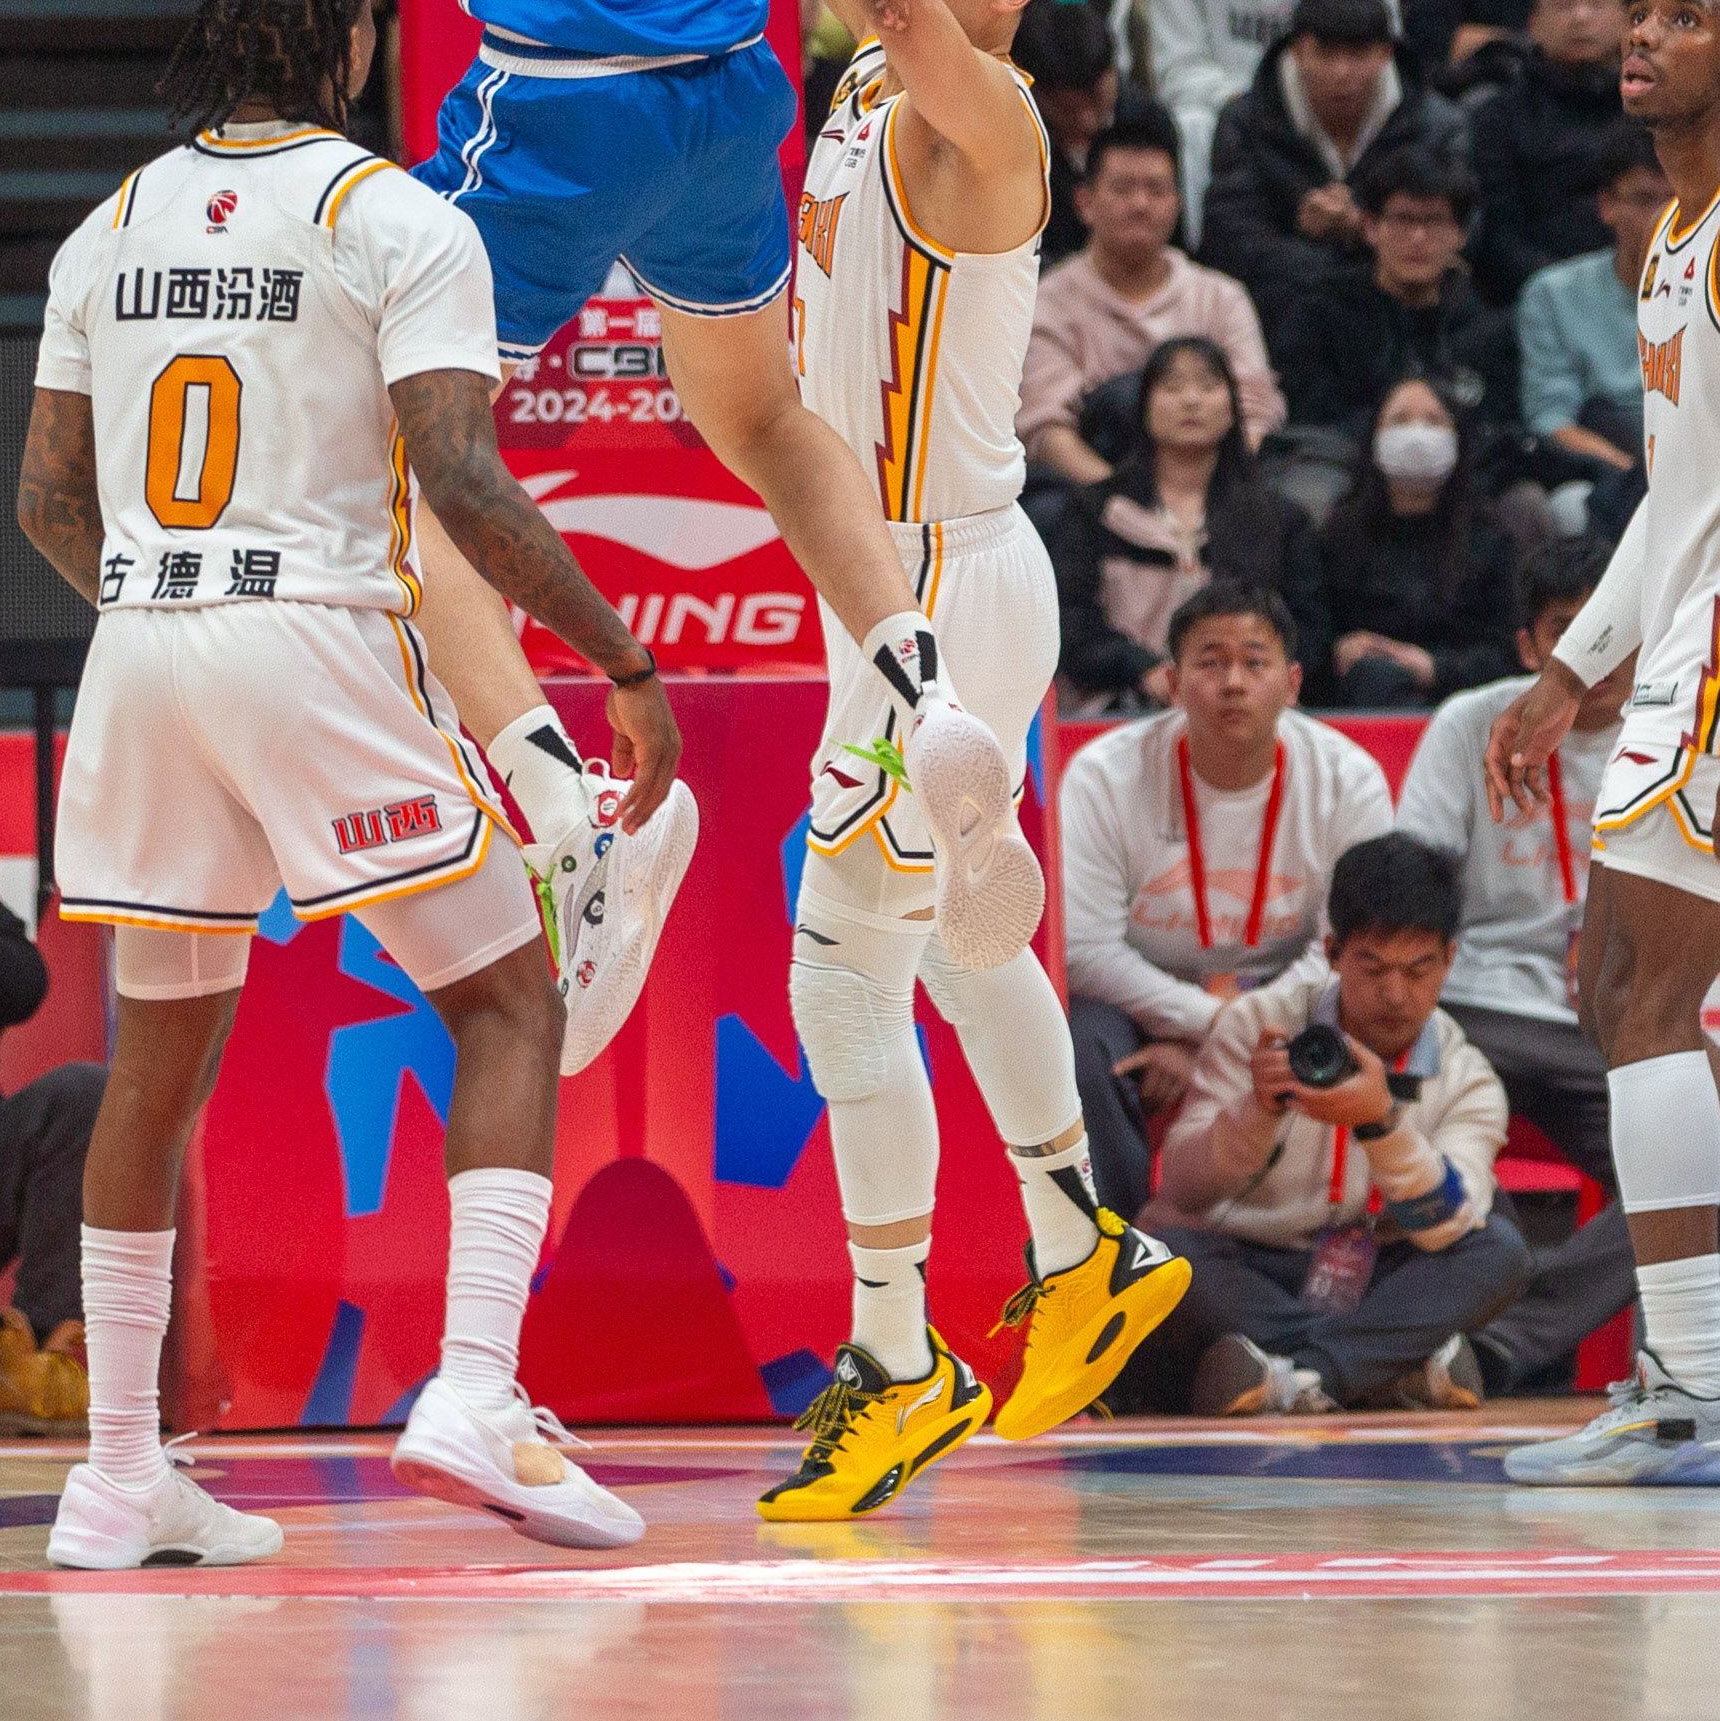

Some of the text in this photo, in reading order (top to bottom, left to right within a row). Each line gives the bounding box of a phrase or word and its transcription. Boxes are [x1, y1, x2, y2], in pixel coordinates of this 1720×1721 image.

[114, 266, 304, 323] 山西汾酒
[509, 388, 692, 424] 2024-20
[144, 353, 244, 530] 0
[330, 793, 444, 856] 山西
